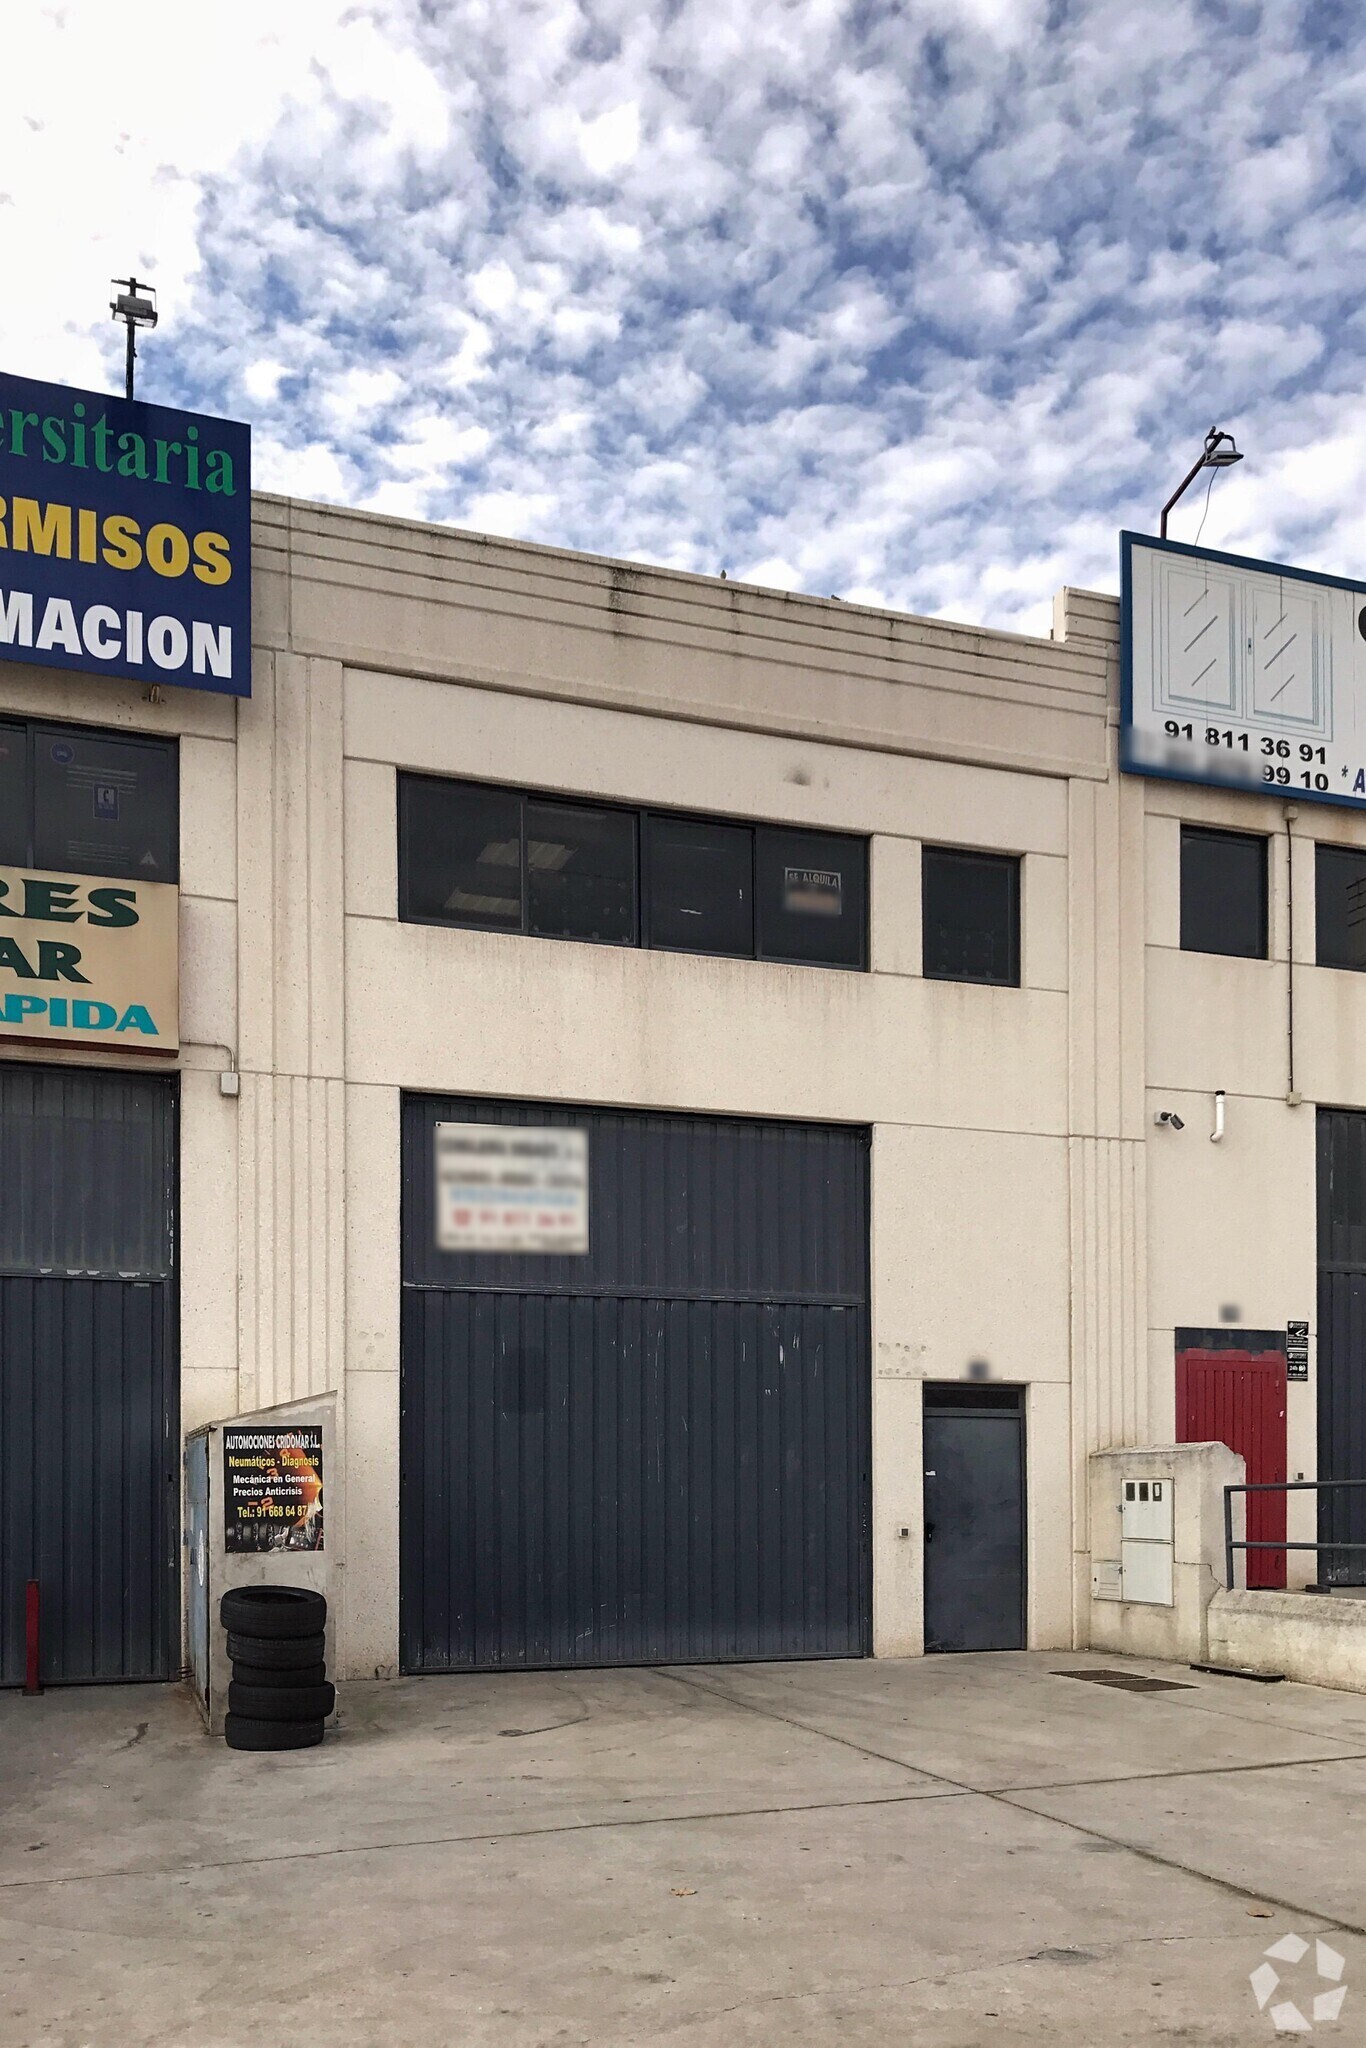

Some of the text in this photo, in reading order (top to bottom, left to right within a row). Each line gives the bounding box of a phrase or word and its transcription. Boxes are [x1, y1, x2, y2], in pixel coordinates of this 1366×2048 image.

[0, 402, 237, 496] rsitaria
[0, 495, 233, 586] MISOS
[1164, 720, 1326, 765] 91 811 36 91
[1263, 765, 1291, 786] 99
[1300, 771, 1329, 791] 10
[802, 872, 838, 888] ALQUILA
[0, 994, 160, 1036] PIDA
[226, 1434, 275, 1450] AUTOMOCIONES
[228, 1455, 275, 1468] Neumáticos
[281, 1455, 319, 1469] Diagnosis
[233, 1474, 315, 1484] Mecánica en General
[233, 1486, 302, 1496] Precios Anticrisis
[256, 1506, 266, 1517] 91
[269, 1505, 283, 1517] 668
[286, 1505, 295, 1516] 64
[297, 1505, 307, 1516] 87
